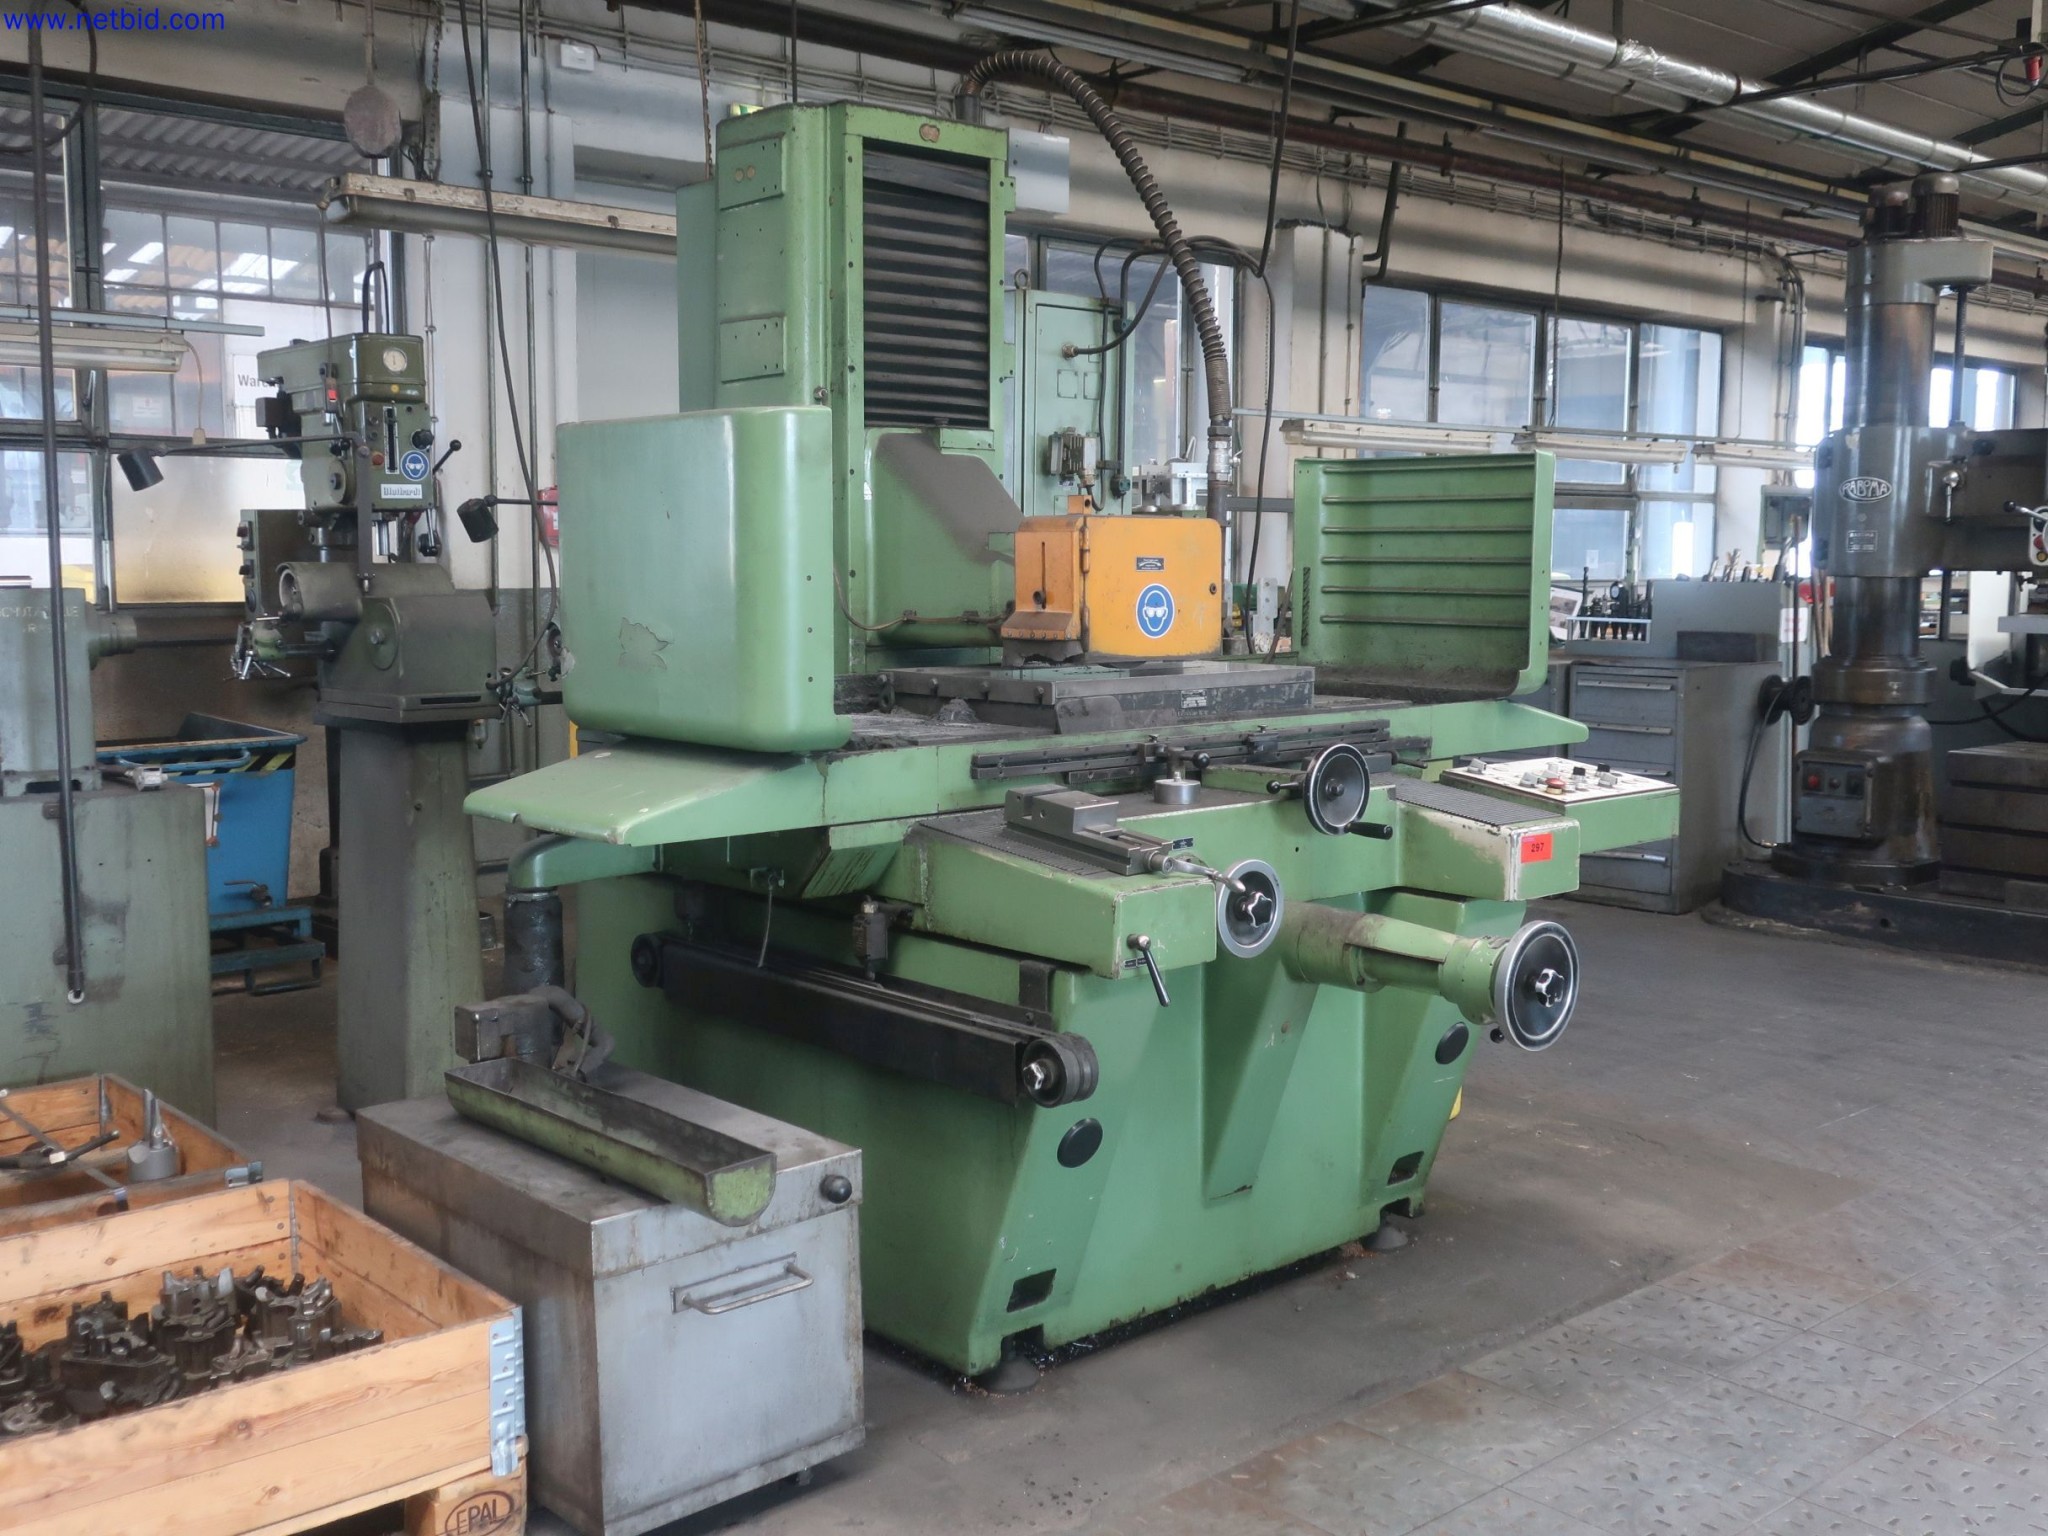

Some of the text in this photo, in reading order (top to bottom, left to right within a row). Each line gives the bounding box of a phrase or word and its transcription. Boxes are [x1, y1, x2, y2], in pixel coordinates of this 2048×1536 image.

[237, 374, 270, 387] Ware
[1843, 480, 1888, 500] RABOMA
[1531, 842, 1544, 853] 297
[456, 1499, 504, 1536] EPAL
